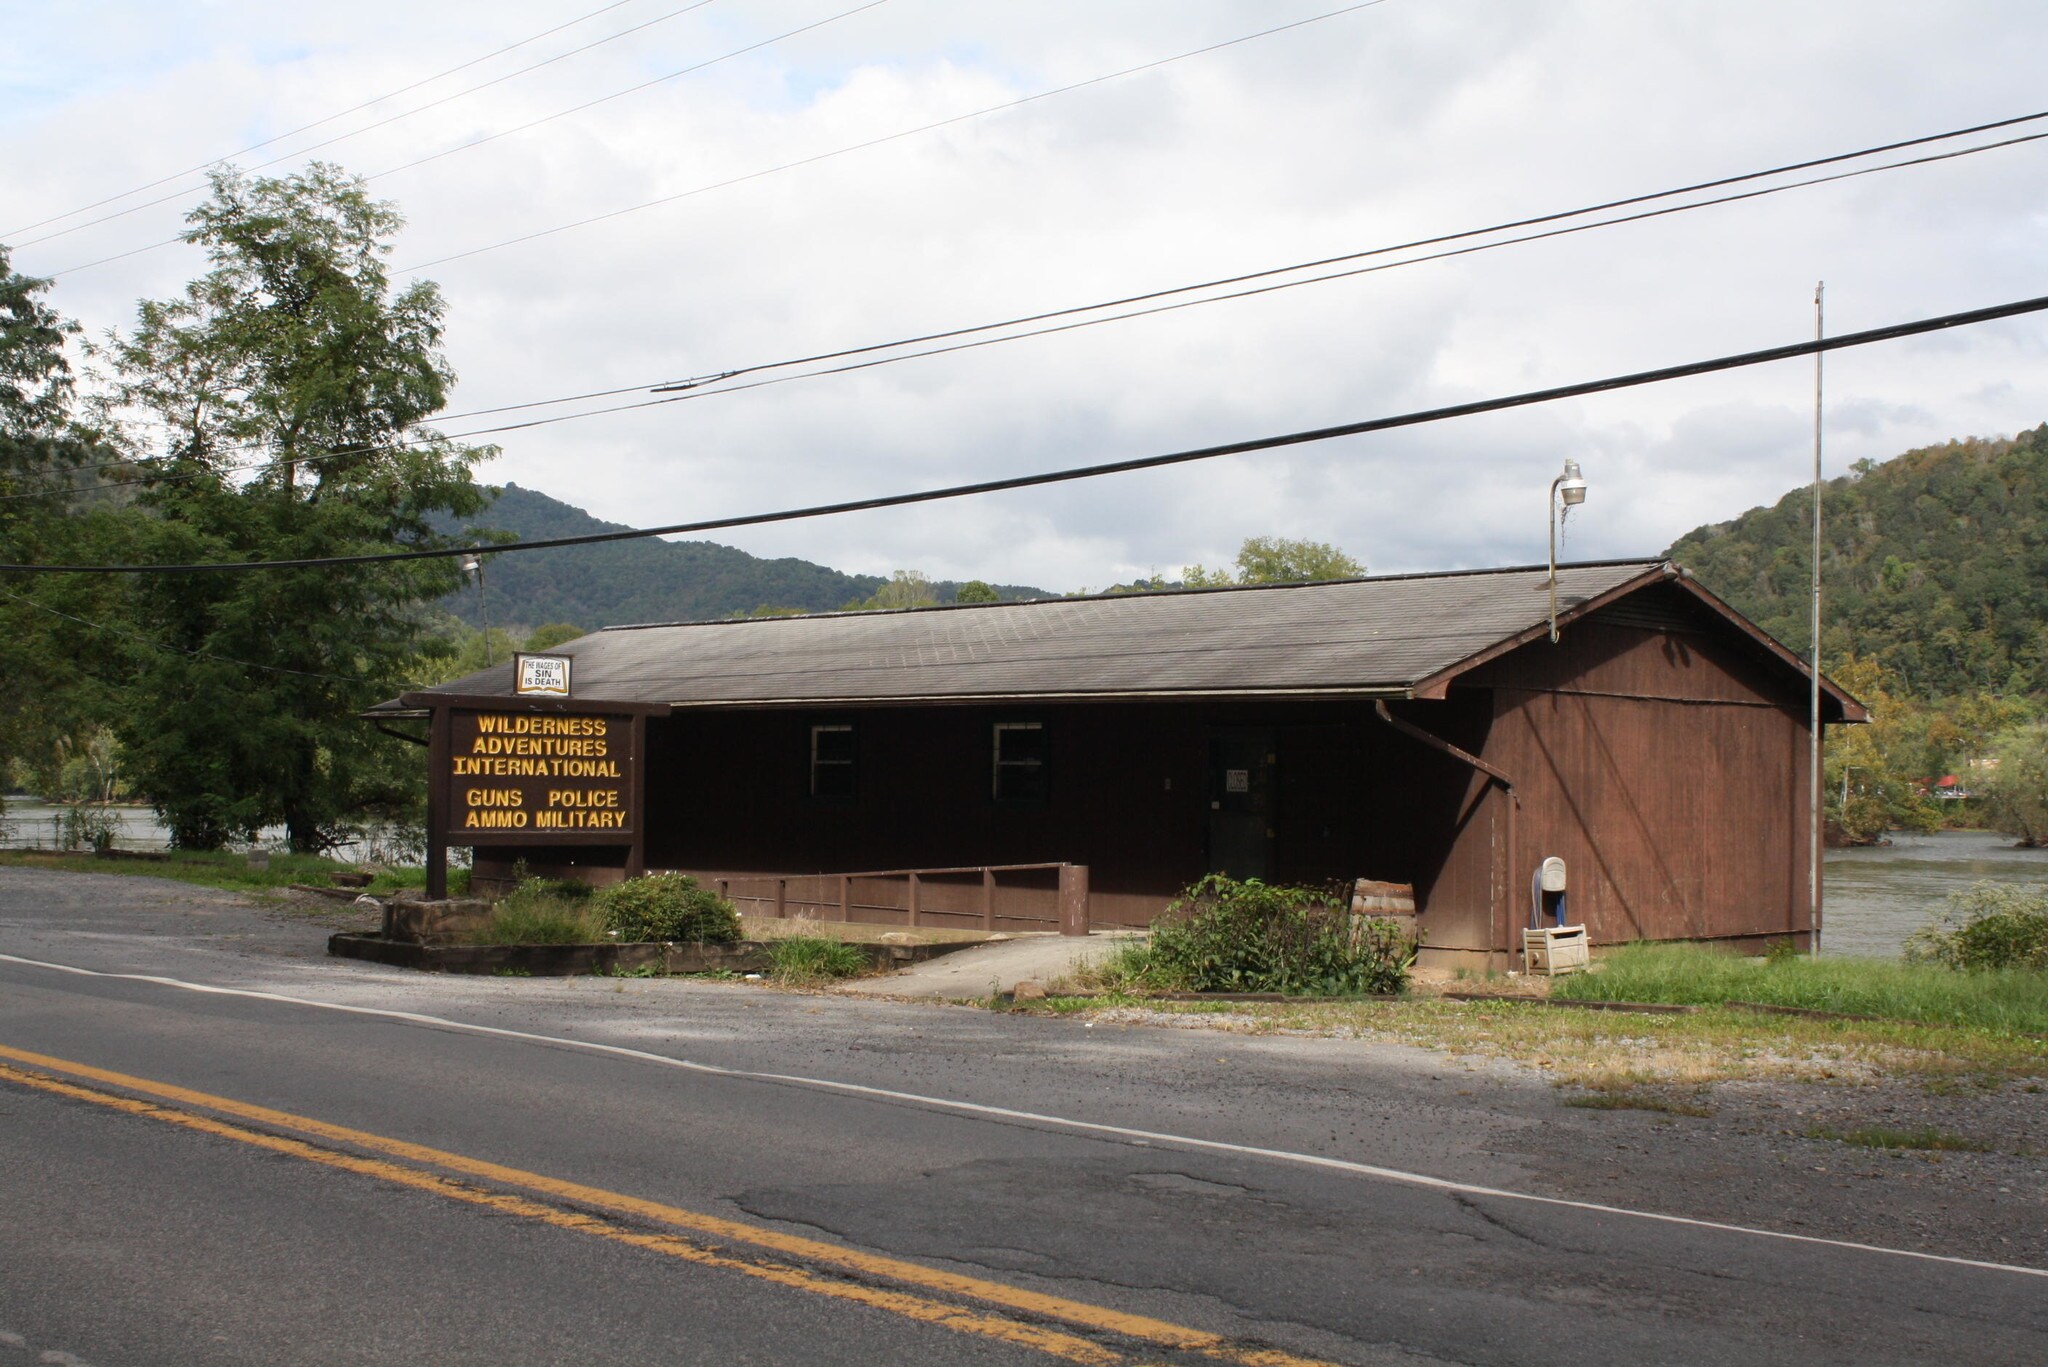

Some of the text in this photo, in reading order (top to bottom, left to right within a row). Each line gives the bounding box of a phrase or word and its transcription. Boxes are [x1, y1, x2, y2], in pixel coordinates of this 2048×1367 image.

[525, 661, 562, 670] THE WAGES OF
[535, 669, 552, 678] SIN
[525, 677, 561, 686] IS DEATH
[478, 715, 607, 736] WILDERNESS
[472, 735, 607, 757] ADVENTURES
[453, 756, 621, 777] INTERNATIONAL
[466, 788, 619, 808] GUNS POLICE
[465, 809, 626, 828] AMMO MILITARY
